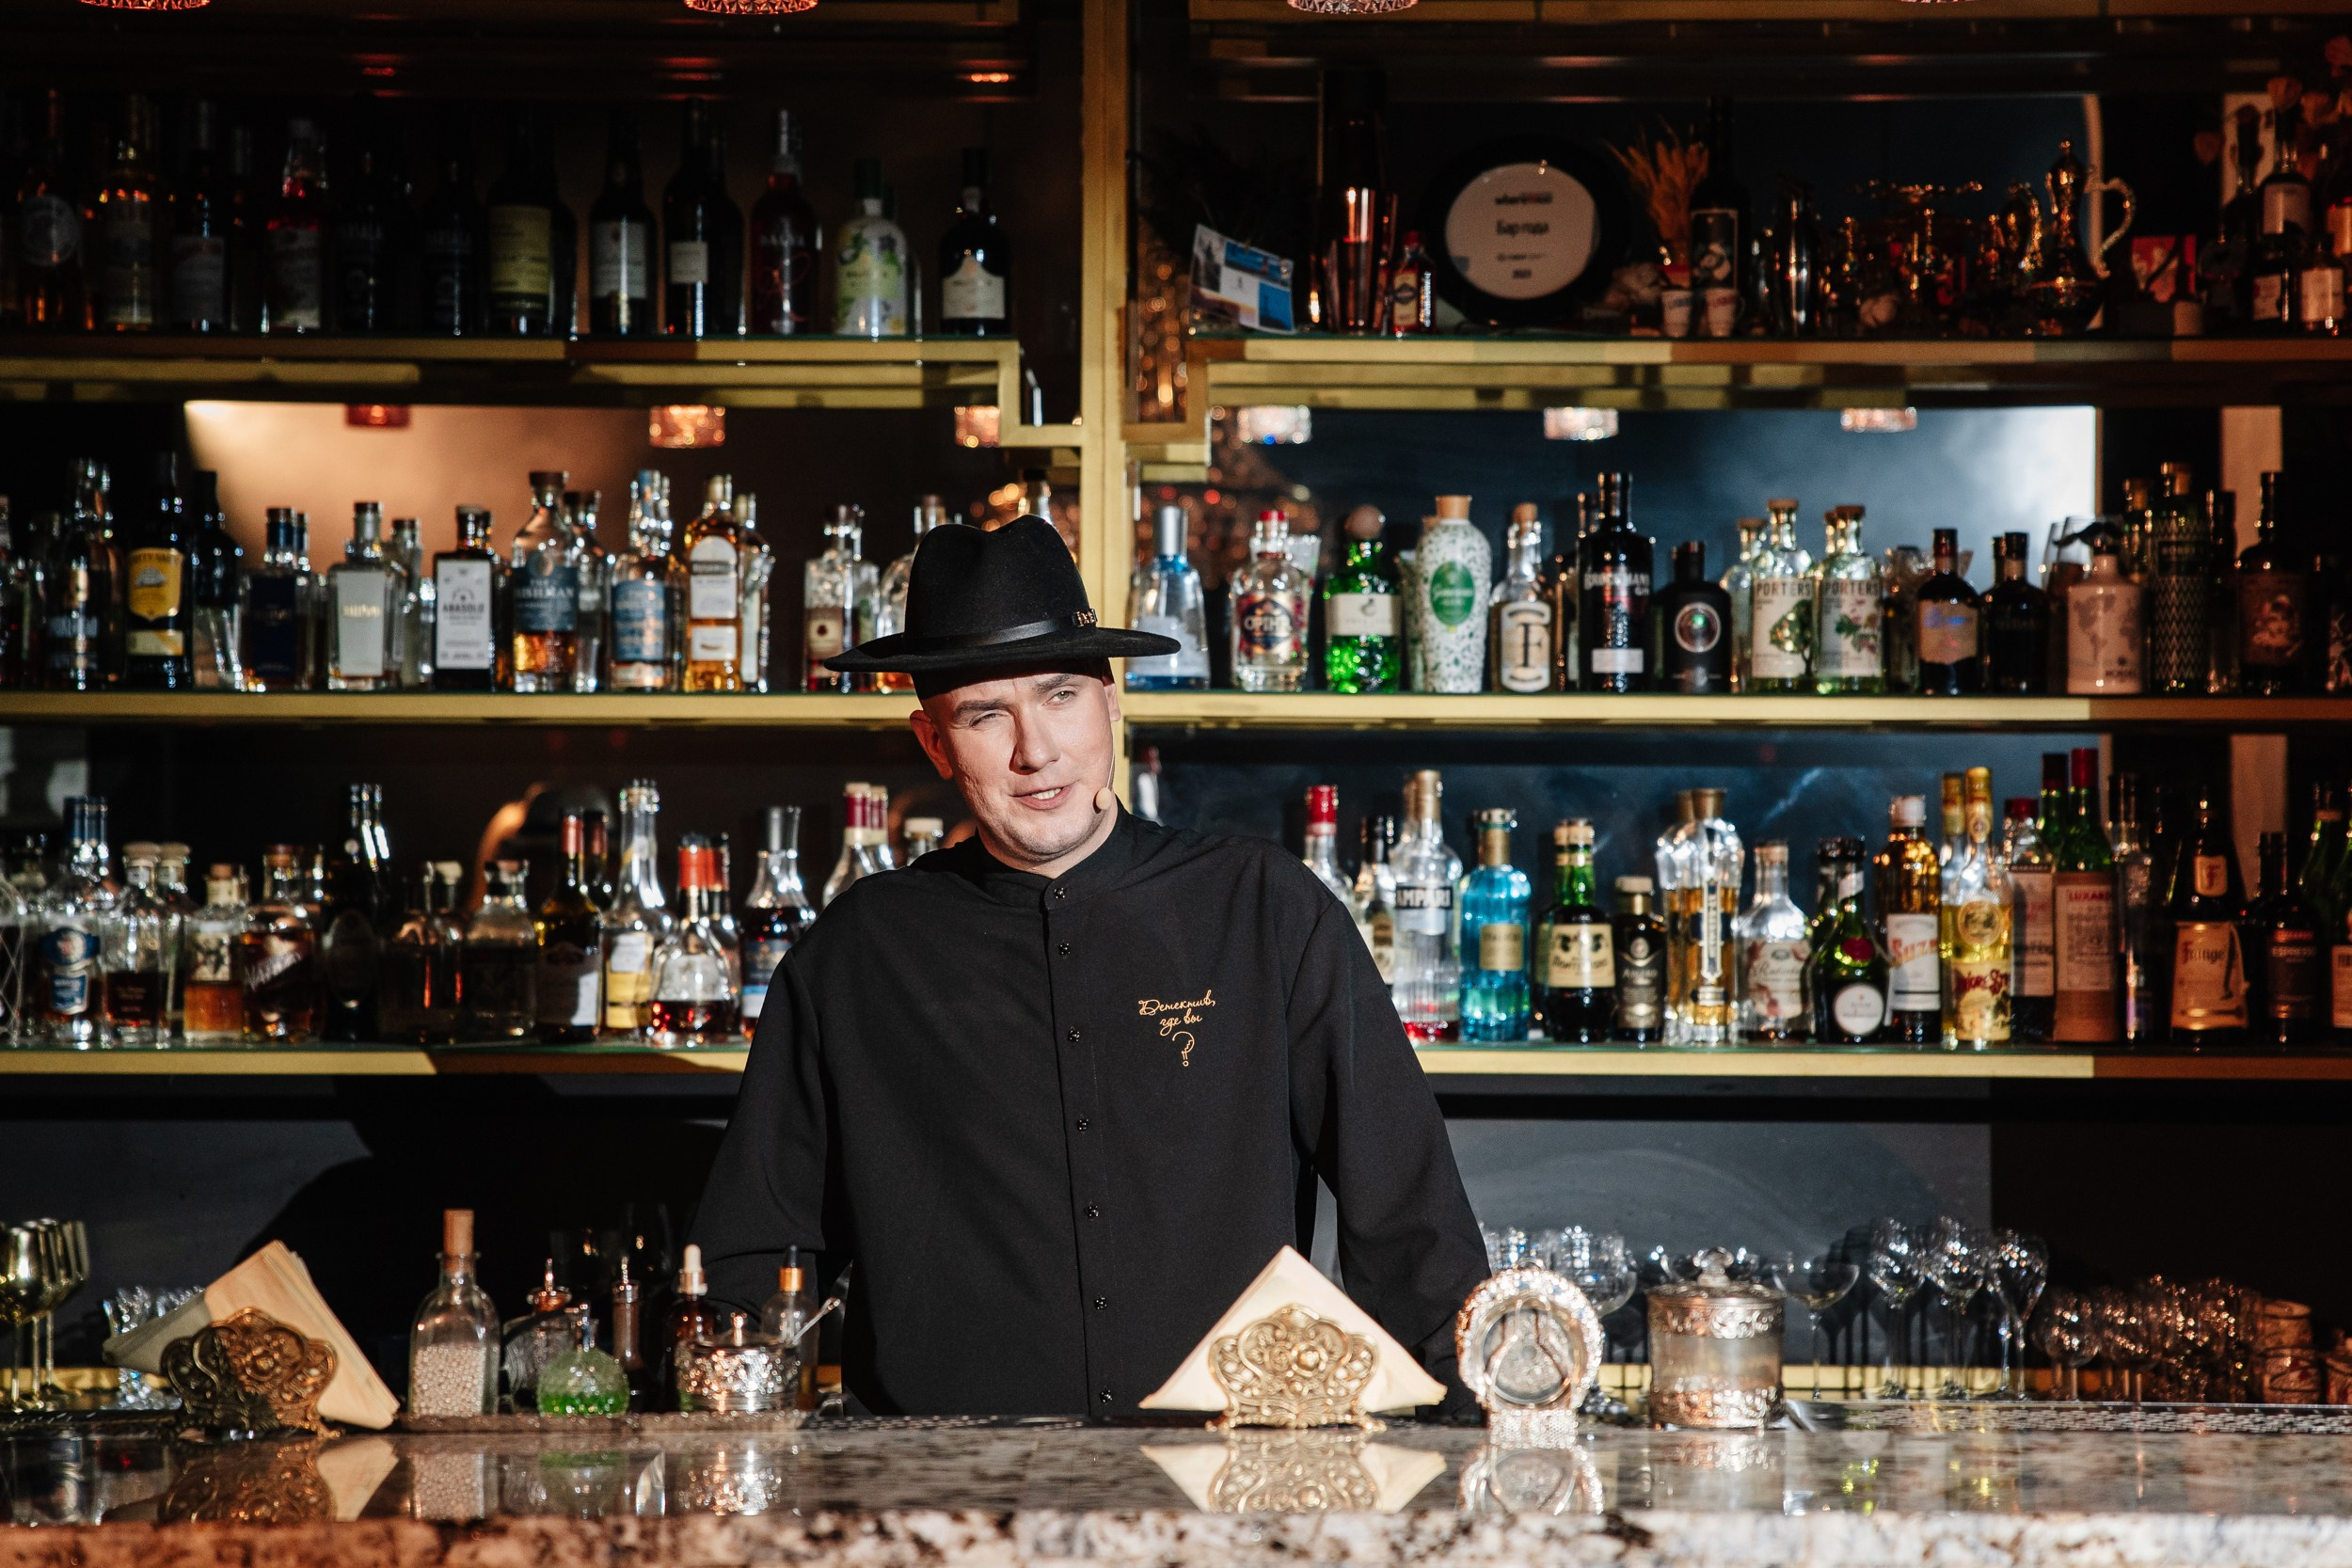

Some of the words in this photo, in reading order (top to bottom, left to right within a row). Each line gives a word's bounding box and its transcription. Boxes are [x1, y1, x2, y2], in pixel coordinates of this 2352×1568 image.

[1756, 583, 1811, 596] PORTERS
[1137, 989, 1216, 1016] Детектив,
[1159, 1017, 1182, 1037] где
[1183, 1007, 1203, 1024] вы
